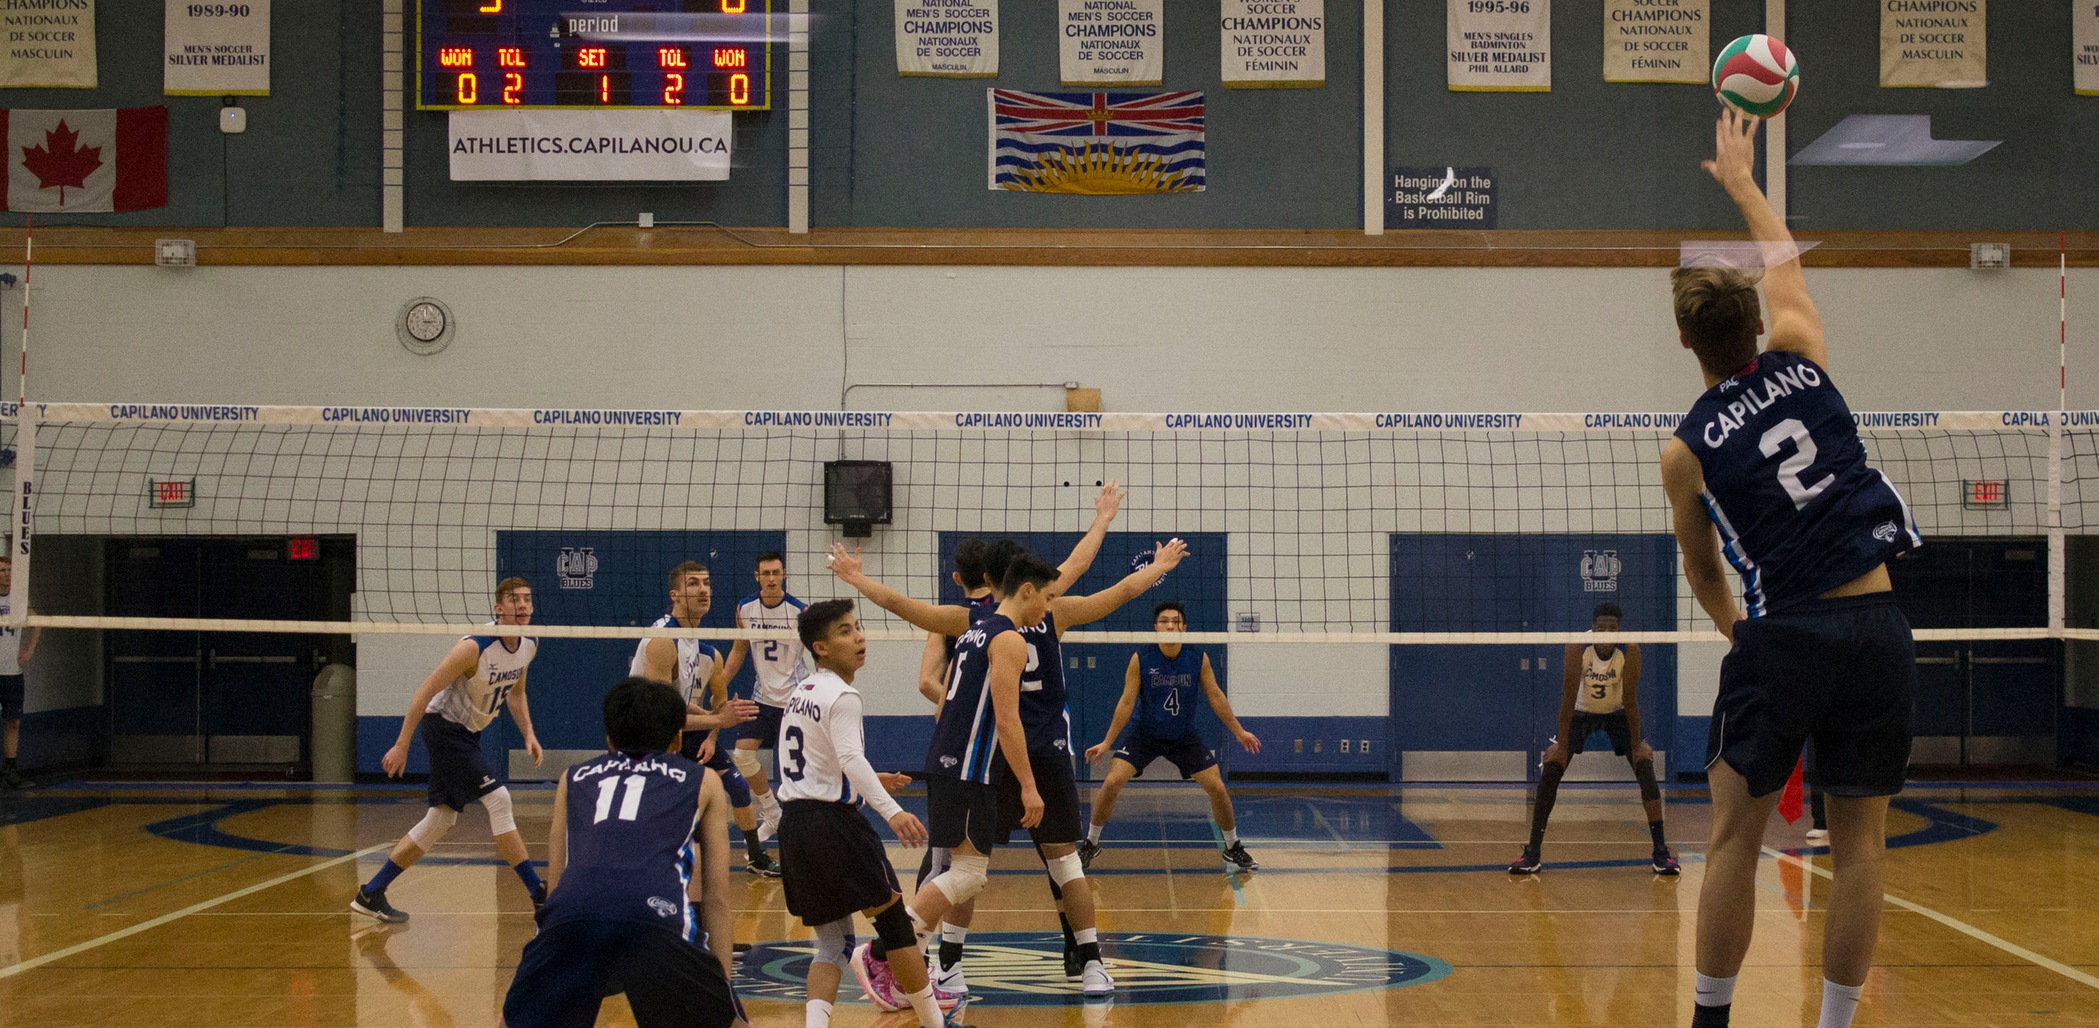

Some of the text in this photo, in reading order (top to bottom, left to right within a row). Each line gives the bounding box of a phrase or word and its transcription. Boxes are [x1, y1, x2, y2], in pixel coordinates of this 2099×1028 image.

[0, 0, 88, 10] HAMPIONS
[186, 4, 250, 18] 1989-90
[1084, 1, 1136, 10] NATIONAL
[1247, 4, 1296, 14] SOCCER
[1467, 1, 1530, 13] 1995-96
[1887, 0, 1977, 12] CHAMPIONS
[906, 9, 990, 18] MEN'S SOCCER
[1068, 12, 1153, 21] MEN'S SOCCER
[1612, 10, 1702, 22] CHAMPIONS
[5, 15, 79, 25] NATIONAUX
[569, 15, 619, 36] period
[1222, 18, 1322, 30] CHAMPIONS
[1896, 18, 1968, 27] NATIONAUX
[904, 21, 993, 34] CHAMPIONS
[1065, 24, 1156, 37] CHAMPIONS
[1620, 26, 1692, 35] NATIONAUX
[10, 32, 75, 42] DE SOCCER
[918, 37, 978, 47] NATIONAUX
[1233, 34, 1311, 45] NATIONAUX
[1464, 32, 1533, 41] MEN'S SINGLES
[1900, 34, 1964, 43] DE SOCCER
[184, 45, 253, 54] MEN'S SOCCER
[1081, 41, 1140, 50] NATIONAUX
[1471, 41, 1526, 49] BADMINTON
[1624, 41, 1688, 51] DE SOCCER
[11, 49, 73, 59] MASCULIN
[579, 49, 606, 66] SET
[917, 48, 981, 57] DE SOCCER
[1078, 51, 1144, 60] DE SOCCER
[1237, 47, 1306, 56] DE SOCCER
[1451, 52, 1547, 63] SILVER MEDALIST
[1902, 50, 1963, 59] MASCULIN
[168, 55, 266, 66] SILVER MEDALIST
[714, 49, 745, 67] WON
[1632, 56, 1681, 69] FÉMININ
[1245, 59, 1298, 71] FÉMININ
[1469, 65, 1529, 73] PHIL ALLARD
[459, 73, 521, 103] 0 2
[602, 75, 607, 102] 1
[665, 74, 748, 104] 2 0
[453, 137, 728, 154] ATHLETICS.CAPILANOU.CA
[1451, 178, 1467, 188] on
[1471, 176, 1491, 188] the
[1466, 191, 1490, 204] Rim
[1404, 207, 1484, 219] is Prohibited
[1703, 363, 1821, 449] CAPILANO
[111, 405, 259, 421] CAPILANO UNIVERSITY
[322, 408, 470, 424] CAPILANO UNIVERSITY
[534, 410, 681, 426] CAPILANO UNIVERSITY
[2002, 412, 2069, 426] CAPILAO
[745, 412, 892, 427] CAPILANO UNIVERSITY
[955, 413, 1103, 428] CAPILANO UNIVERSITY
[1165, 414, 1312, 428] CAPILANO UNIVERSITY
[1375, 414, 1522, 428] CAPILANO UNIVERSITY
[1585, 414, 1651, 428] CAPILANO
[1863, 413, 1939, 427] UNIVERSITY
[1758, 418, 1836, 511] 2
[1975, 482, 1999, 501] EXIT
[21, 481, 32, 555] BLUES
[562, 579, 593, 588] BLUES
[1585, 581, 1616, 590] BLUES
[764, 639, 778, 662] 2
[1591, 684, 1606, 699] 3
[1163, 687, 1180, 716] 4
[784, 725, 807, 782] 3
[594, 774, 646, 825] 11
